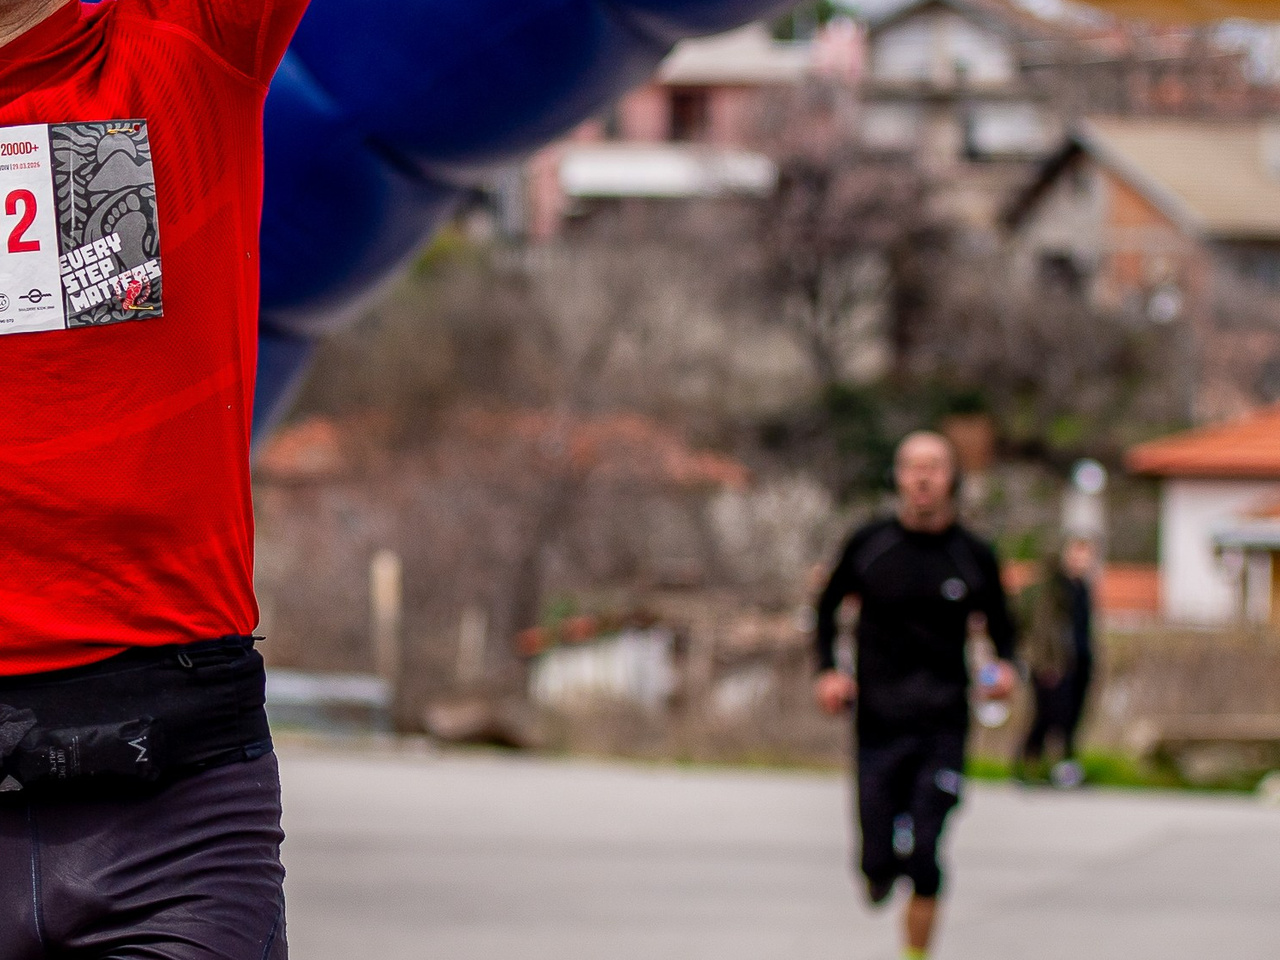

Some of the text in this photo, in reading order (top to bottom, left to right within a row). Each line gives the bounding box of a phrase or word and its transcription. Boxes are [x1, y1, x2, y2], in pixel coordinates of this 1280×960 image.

[59, 232, 122, 275] EVERY
[61, 257, 115, 294] STEP
[70, 259, 162, 312] MATTERS
